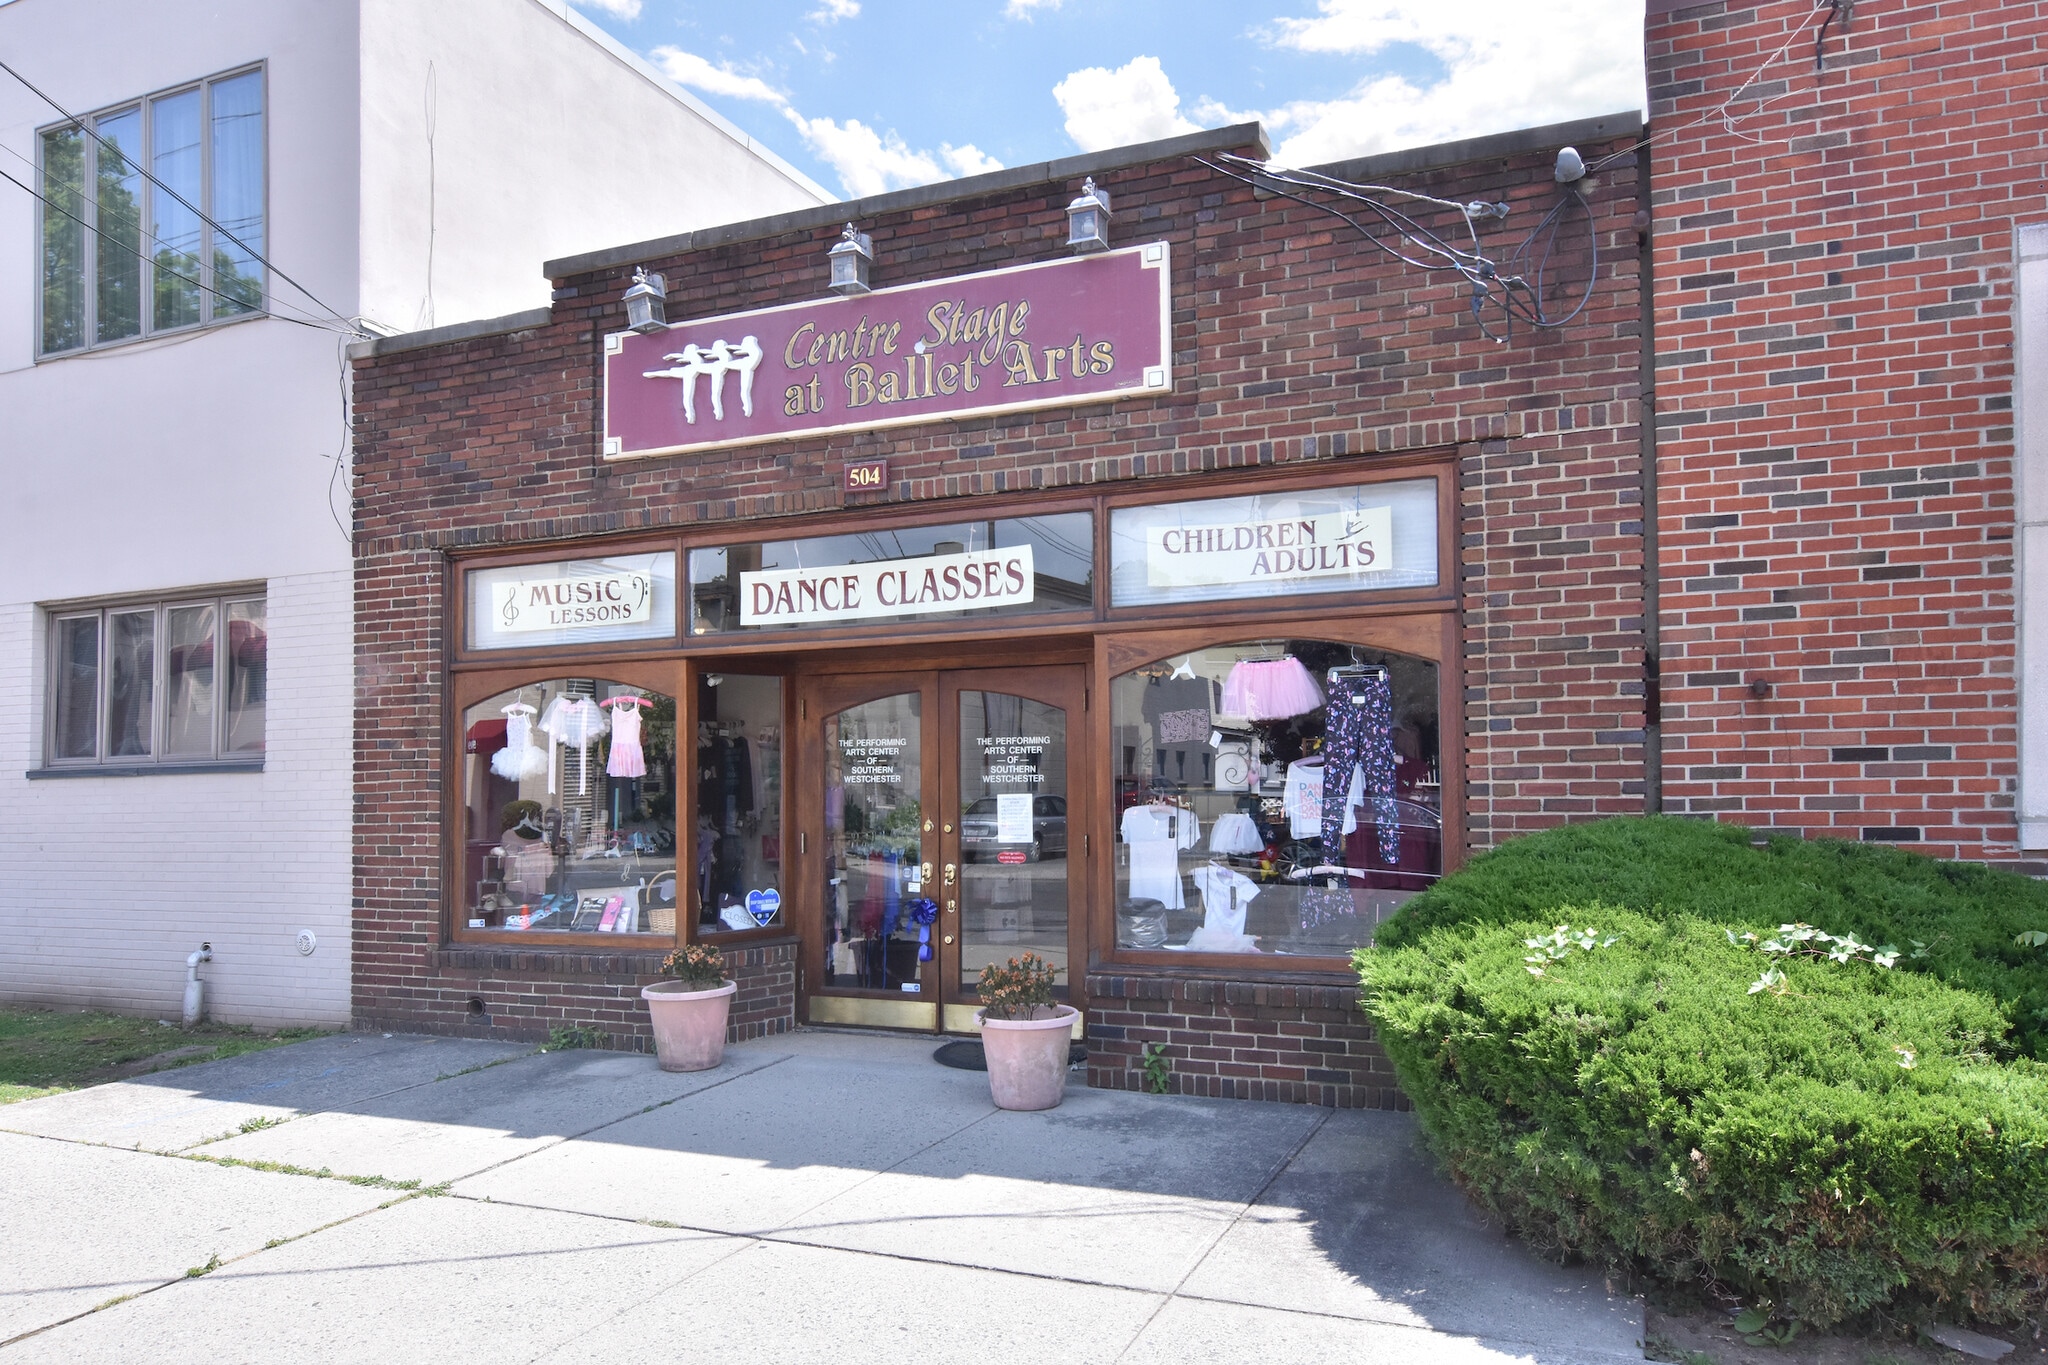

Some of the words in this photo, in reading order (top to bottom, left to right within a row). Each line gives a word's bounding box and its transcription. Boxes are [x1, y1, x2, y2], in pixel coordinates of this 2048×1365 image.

[784, 315, 902, 370] Centre
[921, 299, 1031, 367] Stage
[784, 373, 824, 417] at
[844, 350, 980, 408] Ballet
[1002, 334, 1115, 388] Arts
[849, 466, 881, 487] 504
[1162, 519, 1317, 555] CHILDREN
[1250, 540, 1376, 576] ADULTS
[529, 580, 623, 607] MUSIC
[752, 575, 862, 617] DANCE
[876, 559, 1025, 606] CLASSES
[550, 603, 632, 625] LESSONS
[838, 739, 853, 747] THE
[856, 738, 907, 747] PERFORMING
[976, 737, 993, 746] THE
[995, 736, 1051, 745] PERFORMING
[845, 748, 866, 756] ARTS
[868, 747, 900, 756] CENTER
[984, 746, 1006, 755] ARTS
[1009, 745, 1043, 754] CENTER
[851, 766, 894, 774] SOUTHERN
[990, 765, 1037, 774] SOUTHERN
[844, 775, 902, 783] WESTCHESTER
[982, 774, 1045, 783] WESTCHESTER
